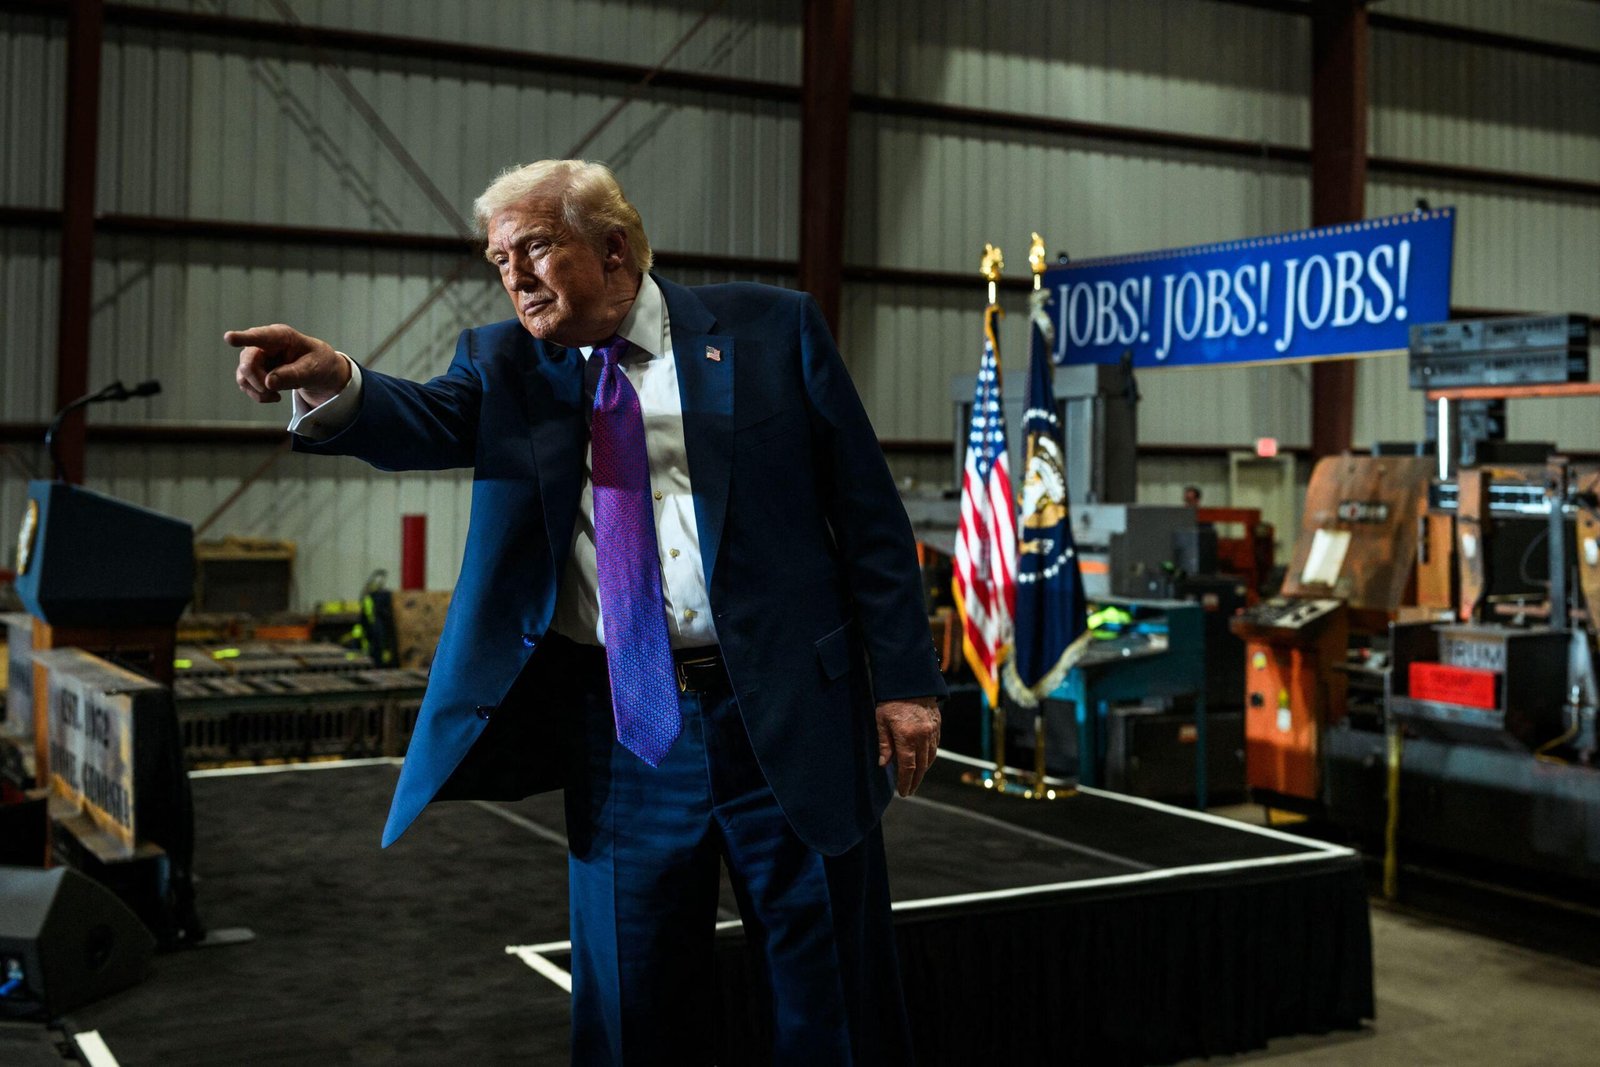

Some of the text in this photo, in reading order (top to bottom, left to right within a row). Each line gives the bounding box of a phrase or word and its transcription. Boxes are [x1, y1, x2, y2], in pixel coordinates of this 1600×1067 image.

[1053, 275, 1151, 363] JOBS!
[1155, 260, 1270, 360] JOBS!
[1275, 239, 1411, 352] JOBS!
